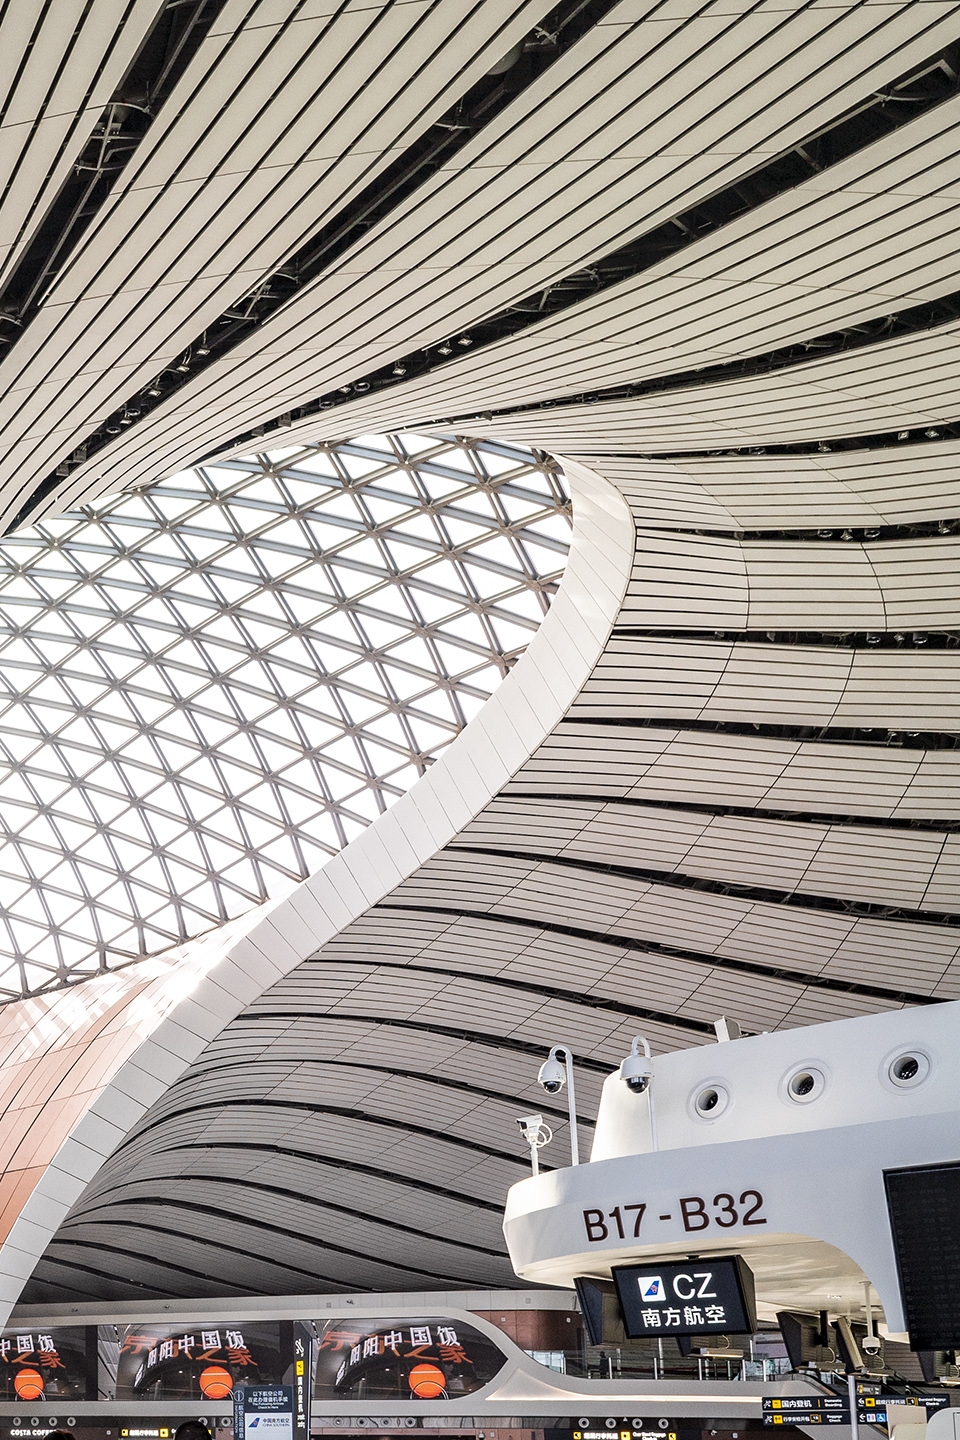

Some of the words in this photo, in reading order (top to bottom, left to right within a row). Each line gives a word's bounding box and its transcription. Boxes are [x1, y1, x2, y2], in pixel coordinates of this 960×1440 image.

[583, 1203, 647, 1242] B17
[679, 1190, 767, 1232] B32
[672, 1272, 717, 1300] CZ
[641, 1304, 727, 1328] 南方航空
[10, 1428, 31, 1436] COSTA
